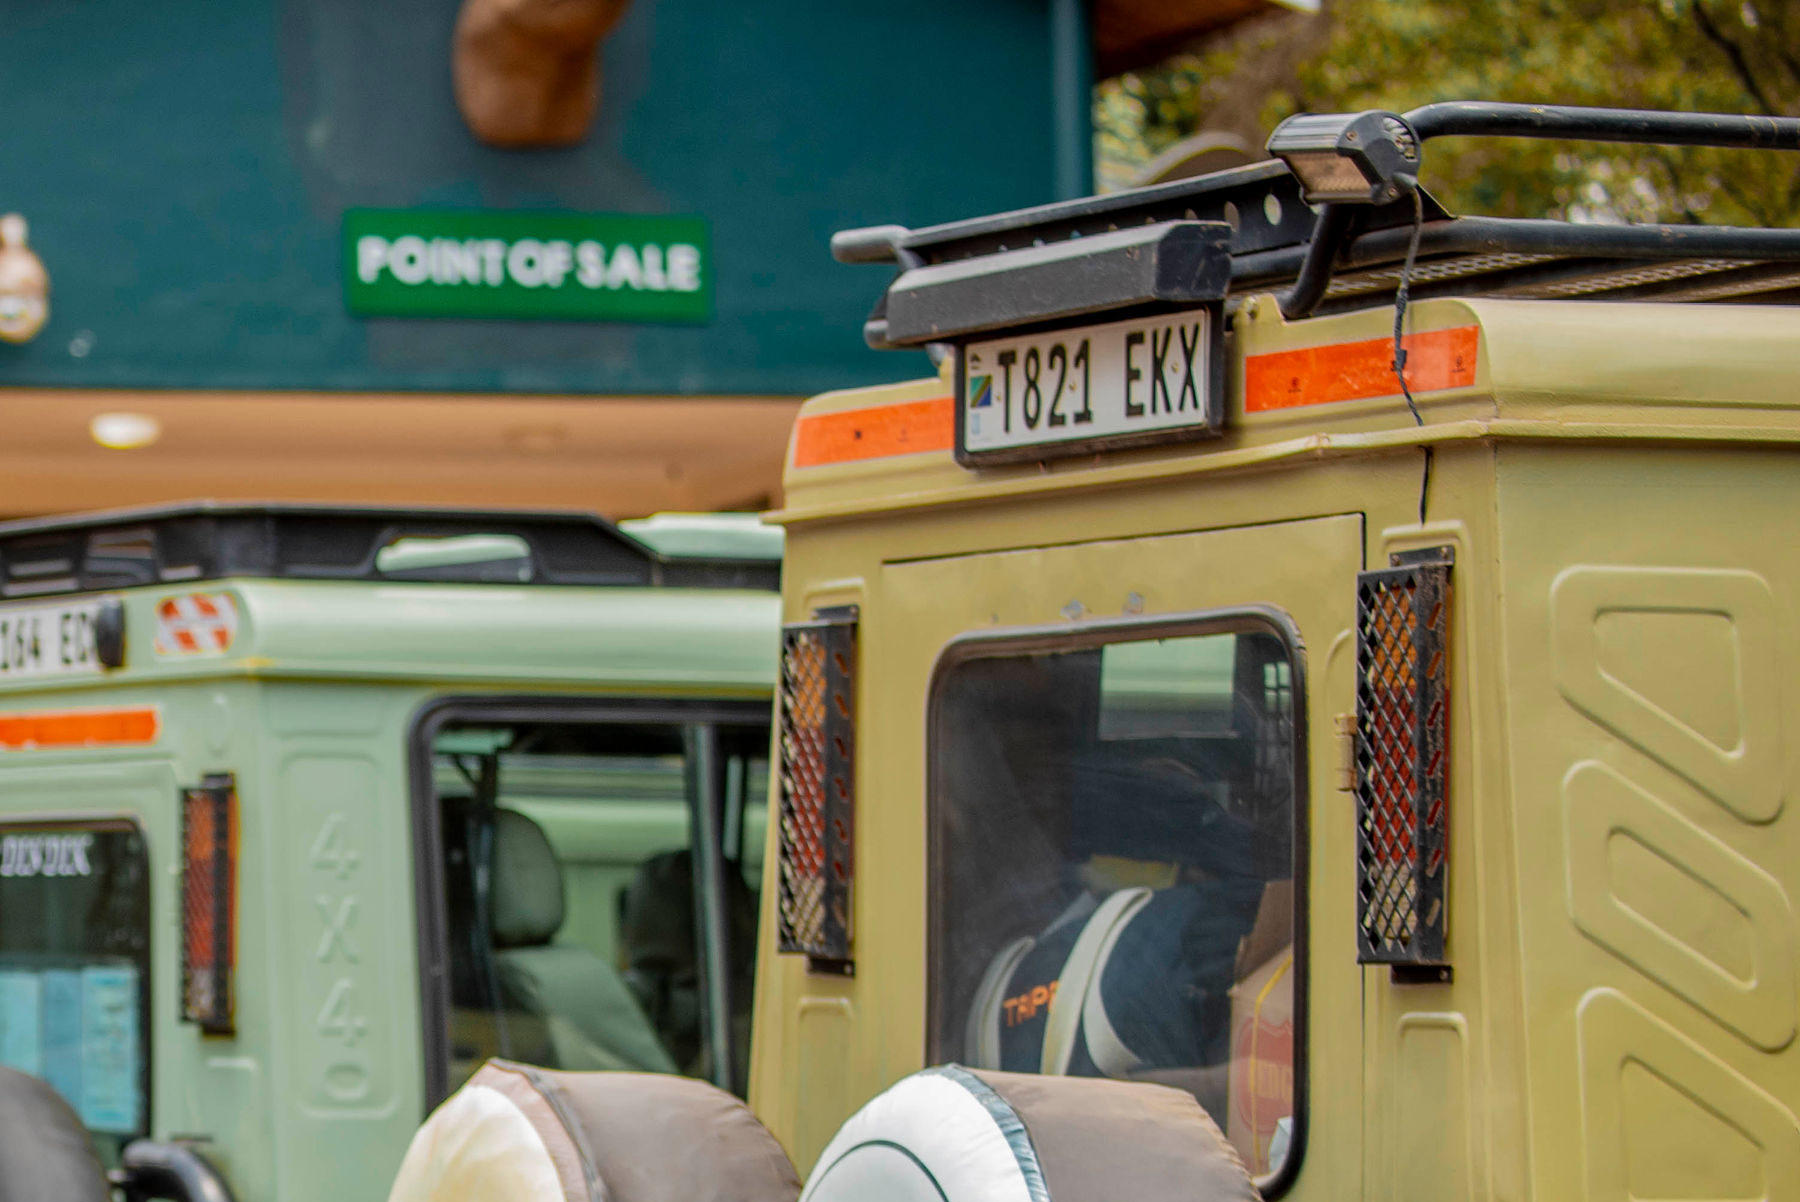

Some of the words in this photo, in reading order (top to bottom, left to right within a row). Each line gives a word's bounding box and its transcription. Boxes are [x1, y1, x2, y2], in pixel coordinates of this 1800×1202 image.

[357, 234, 507, 287] POINT
[508, 237, 574, 289] OF
[576, 239, 701, 293] SALE
[997, 337, 1094, 434] T821
[1124, 322, 1200, 418] EKX
